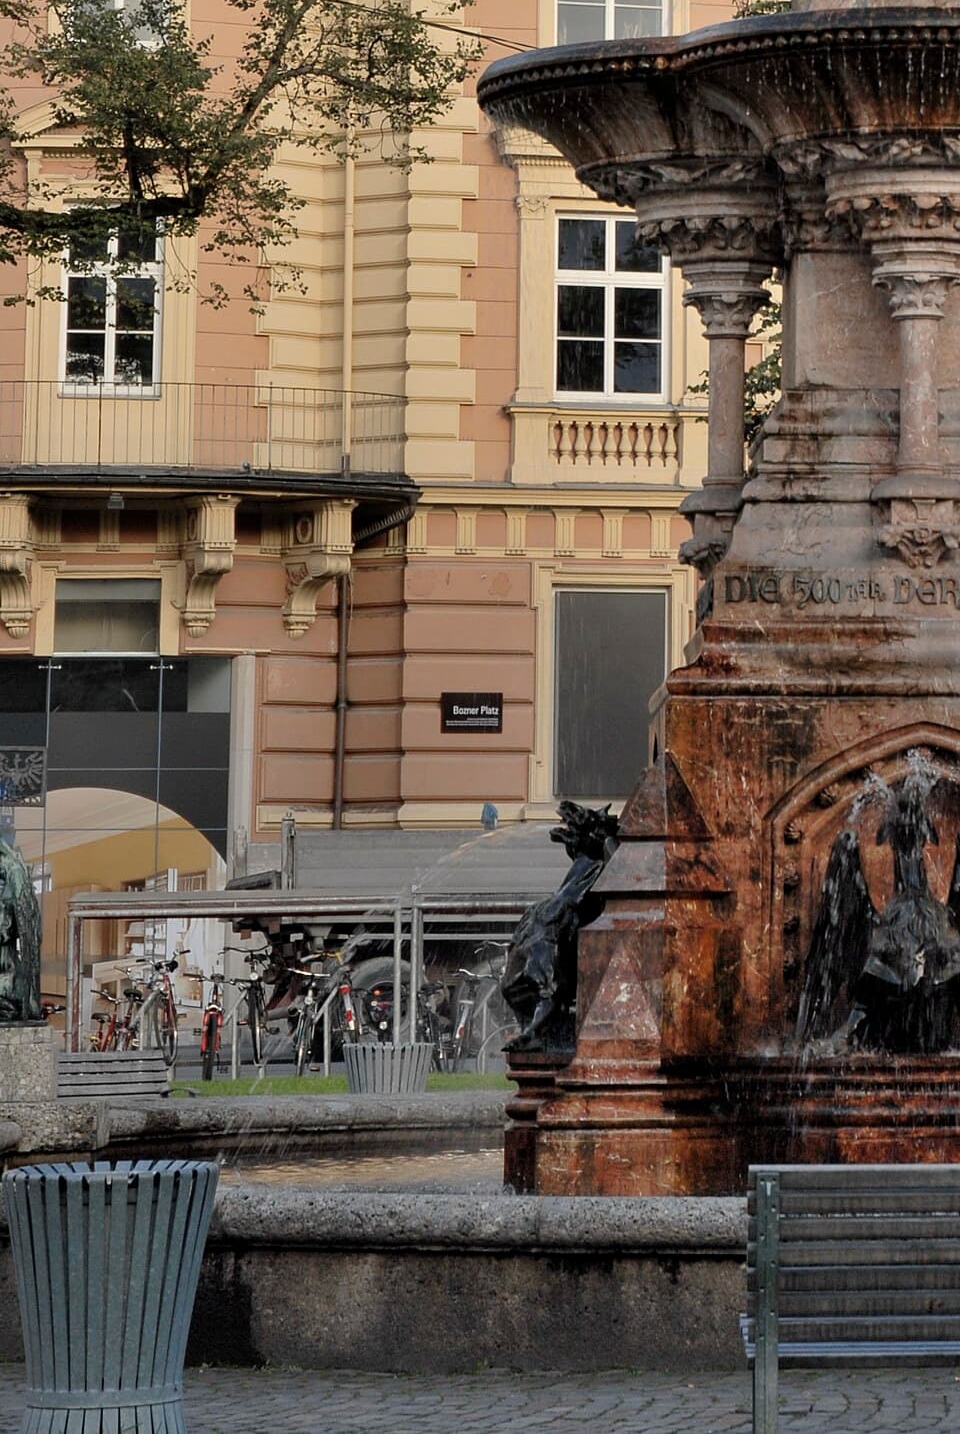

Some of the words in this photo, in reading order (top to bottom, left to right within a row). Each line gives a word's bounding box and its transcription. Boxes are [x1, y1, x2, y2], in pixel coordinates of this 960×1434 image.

[725, 575, 781, 603] DIE
[793, 575, 841, 610] 500
[453, 706, 479, 715] Bozner
[480, 705, 499, 715] Platz
